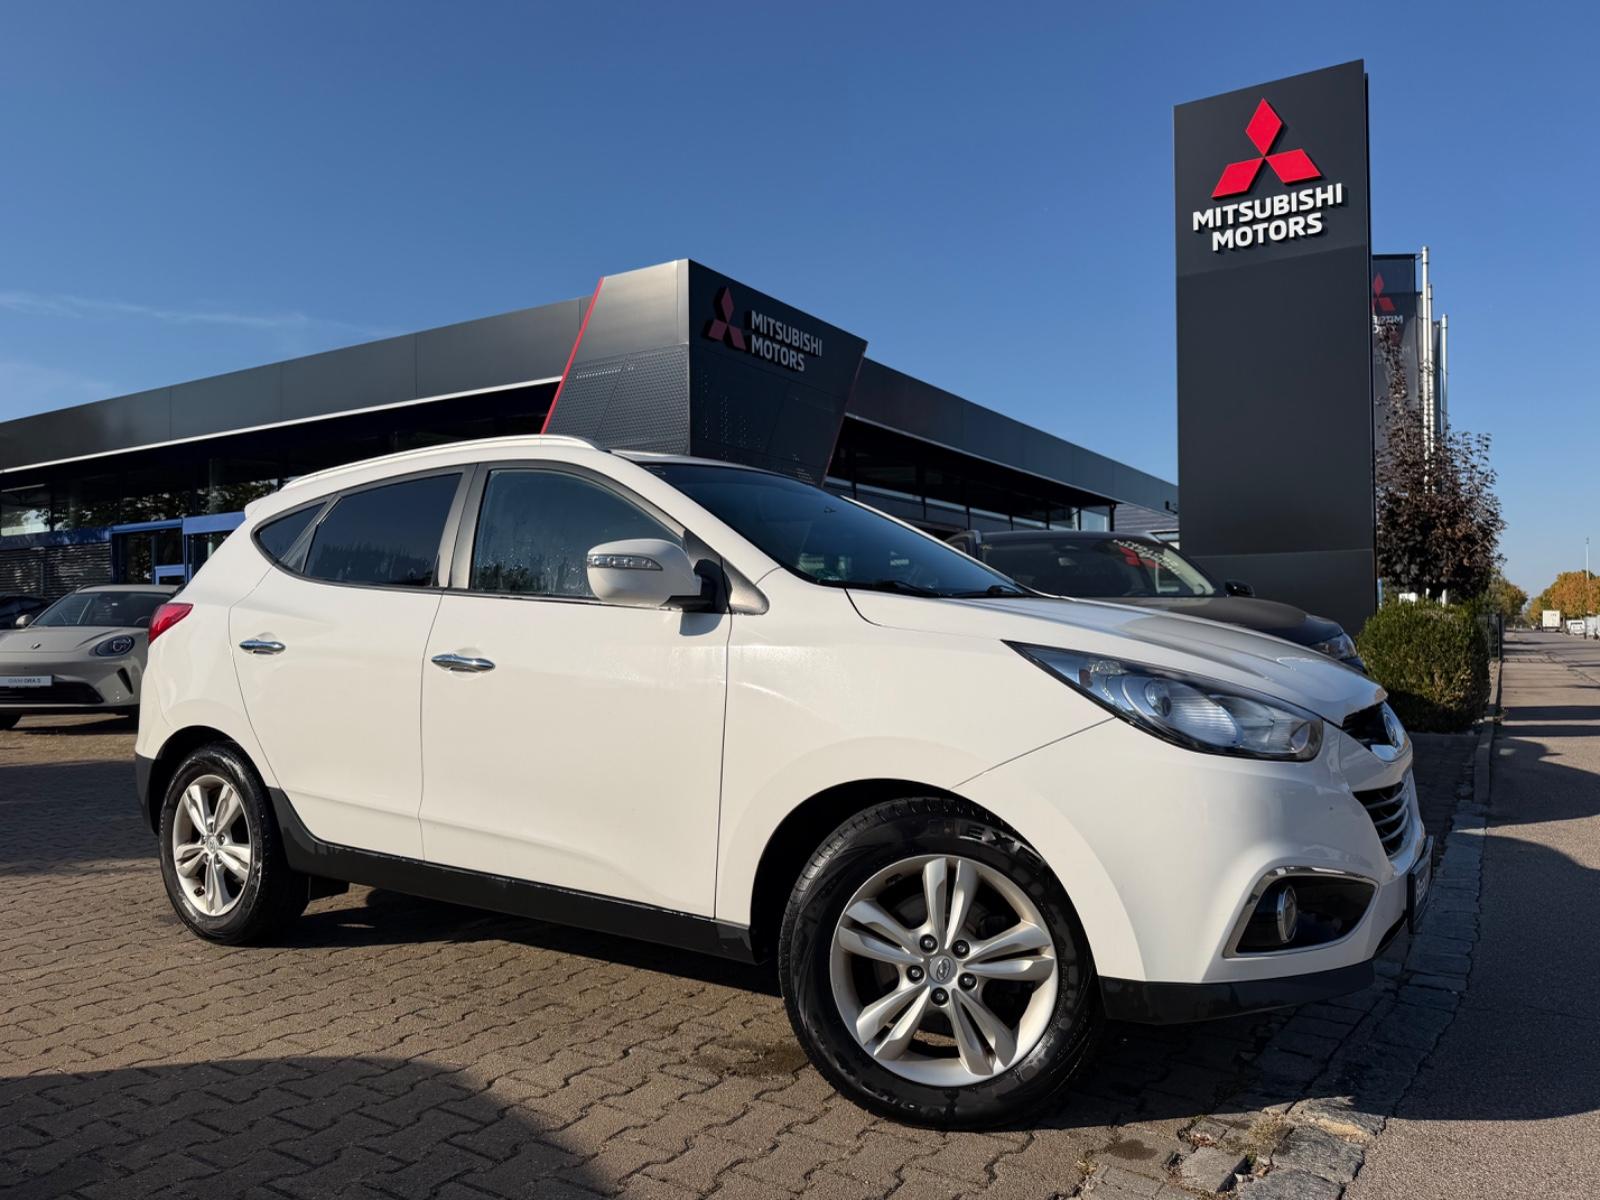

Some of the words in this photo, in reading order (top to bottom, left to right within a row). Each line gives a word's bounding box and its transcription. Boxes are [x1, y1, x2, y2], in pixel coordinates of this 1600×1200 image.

[1192, 182, 1343, 232] MITSUBISHI
[1212, 212, 1323, 252] MOTORS
[751, 309, 823, 357] MITSUBISHI
[751, 334, 805, 372] MOTORS
